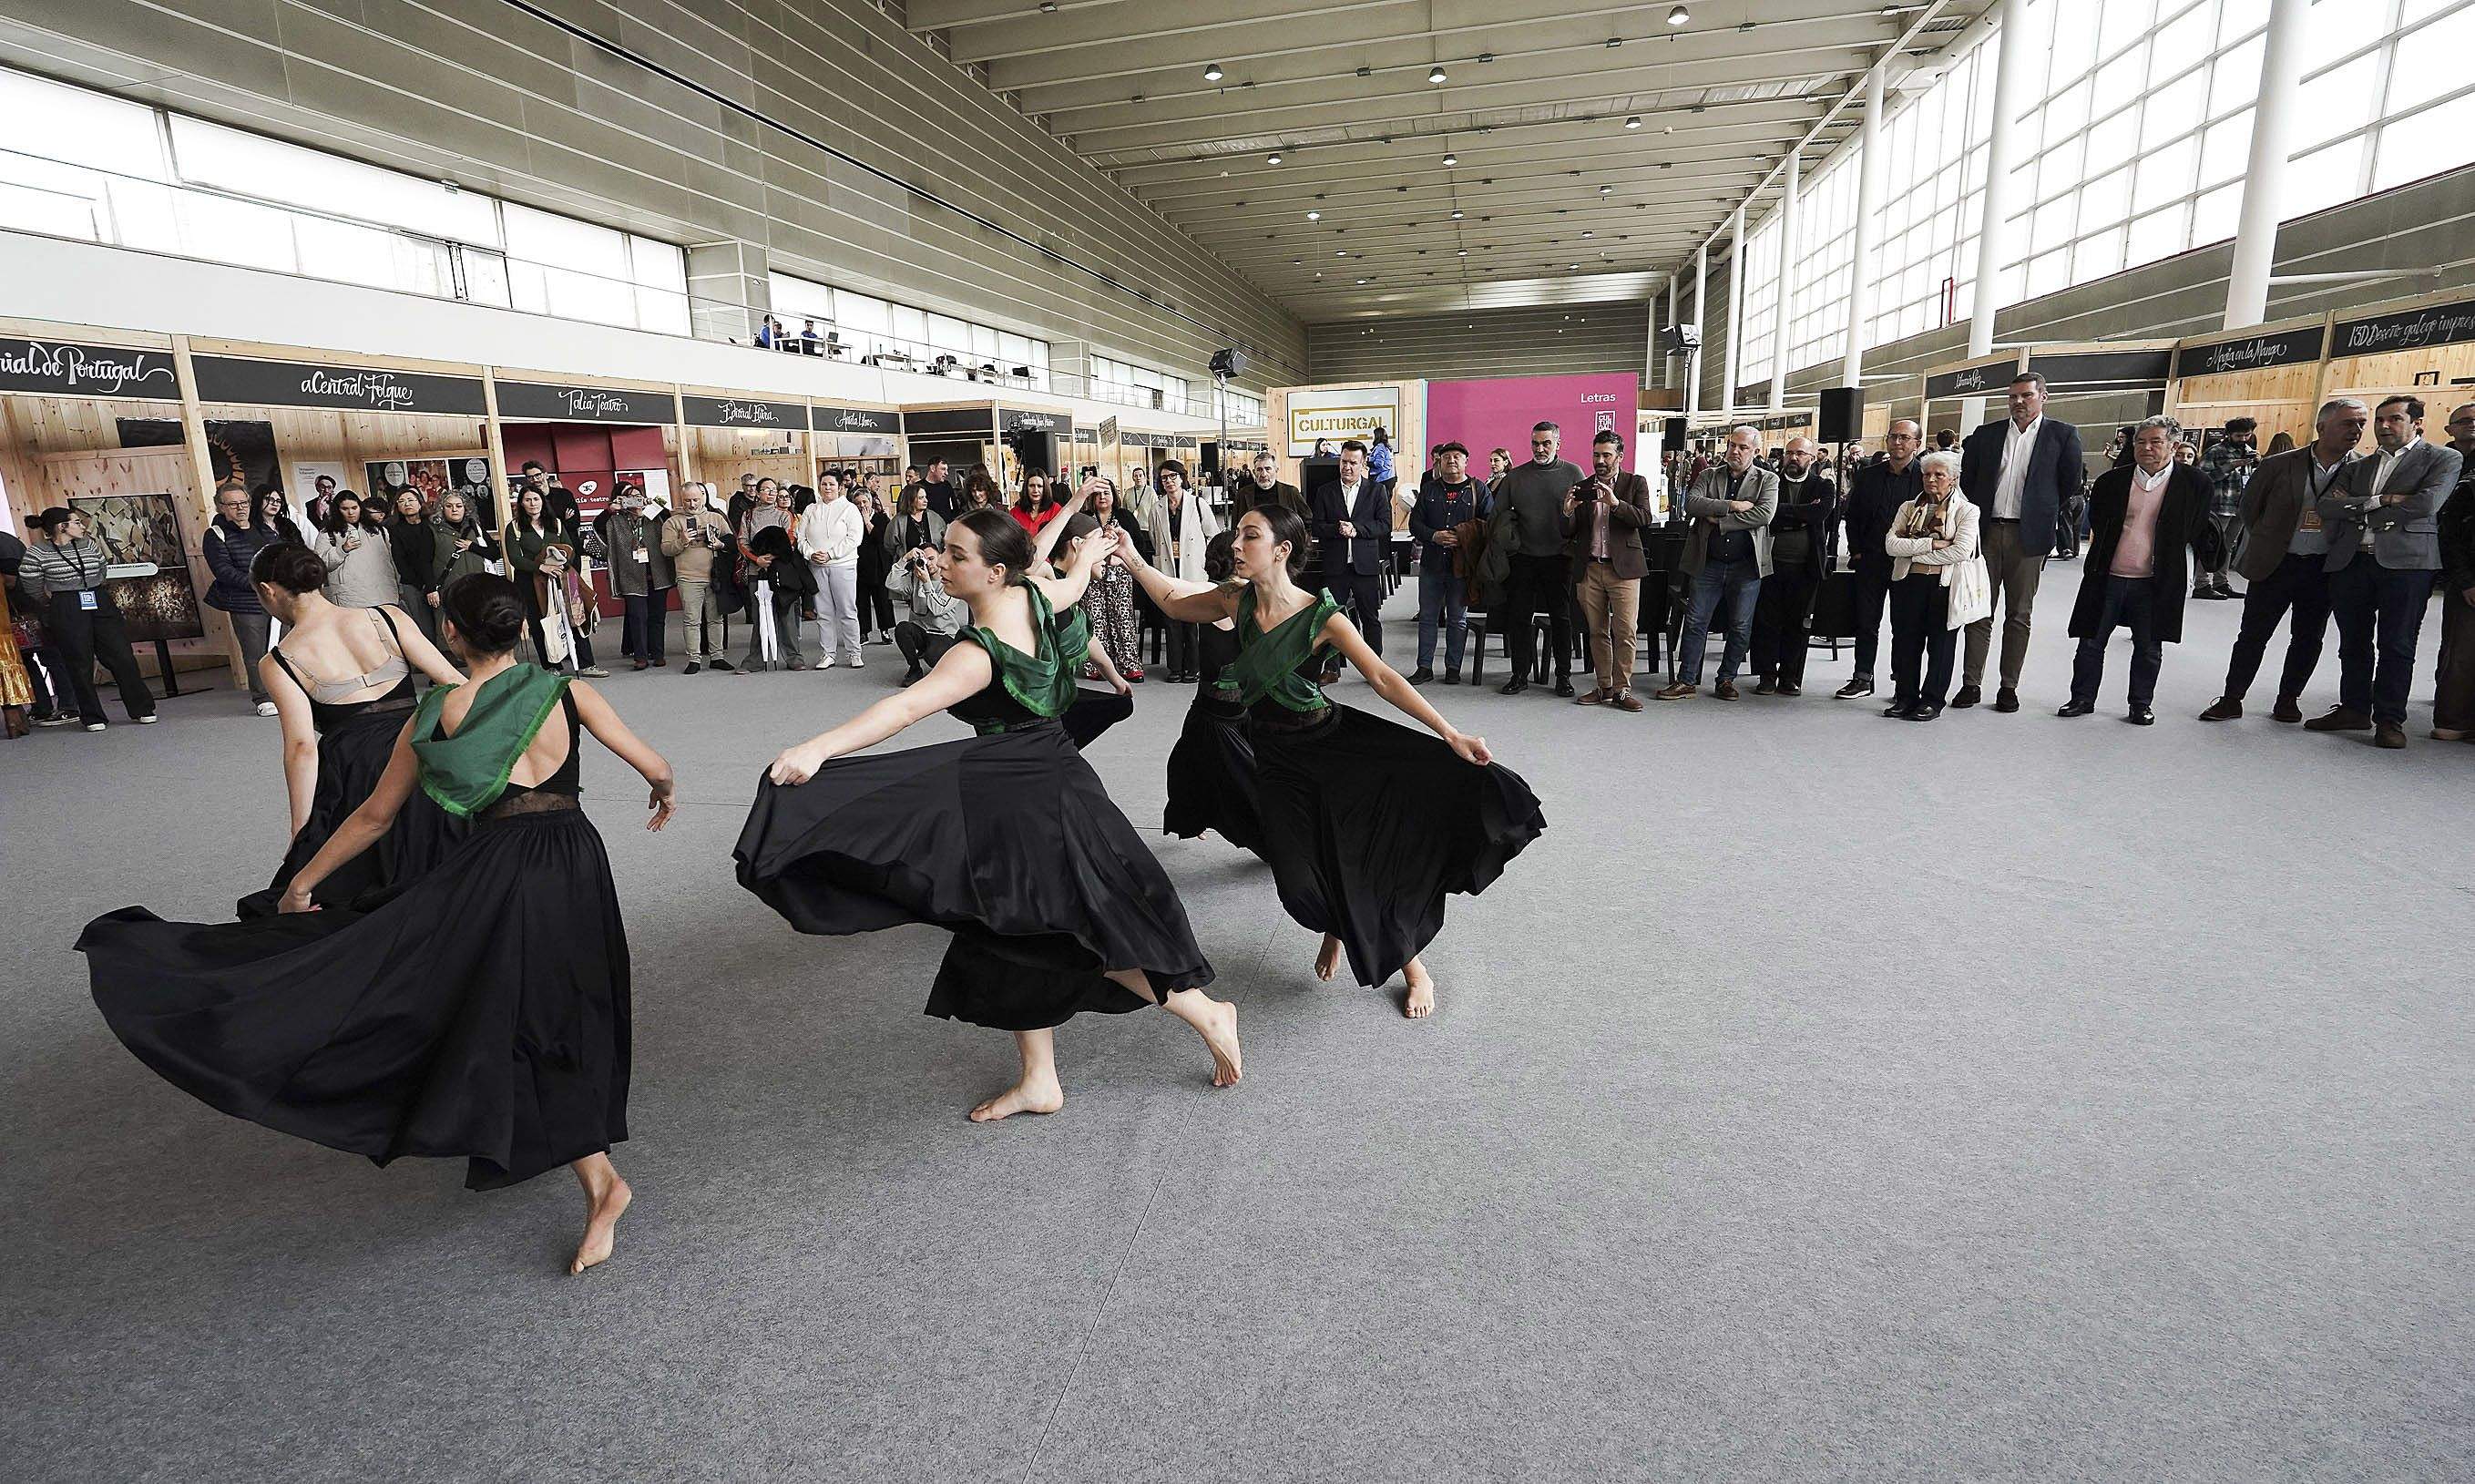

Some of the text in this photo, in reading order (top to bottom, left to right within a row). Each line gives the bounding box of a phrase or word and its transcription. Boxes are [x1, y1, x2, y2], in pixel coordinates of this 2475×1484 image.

[2398, 313, 2437, 346] galego
[2250, 339, 2287, 365] Manga
[29, 341, 63, 377] de
[53, 346, 175, 394] Portugal
[364, 374, 414, 410] Folque
[590, 393, 629, 417] Teatro
[1580, 393, 1616, 404] Letras
[1298, 415, 1387, 432] CULTURGAL
